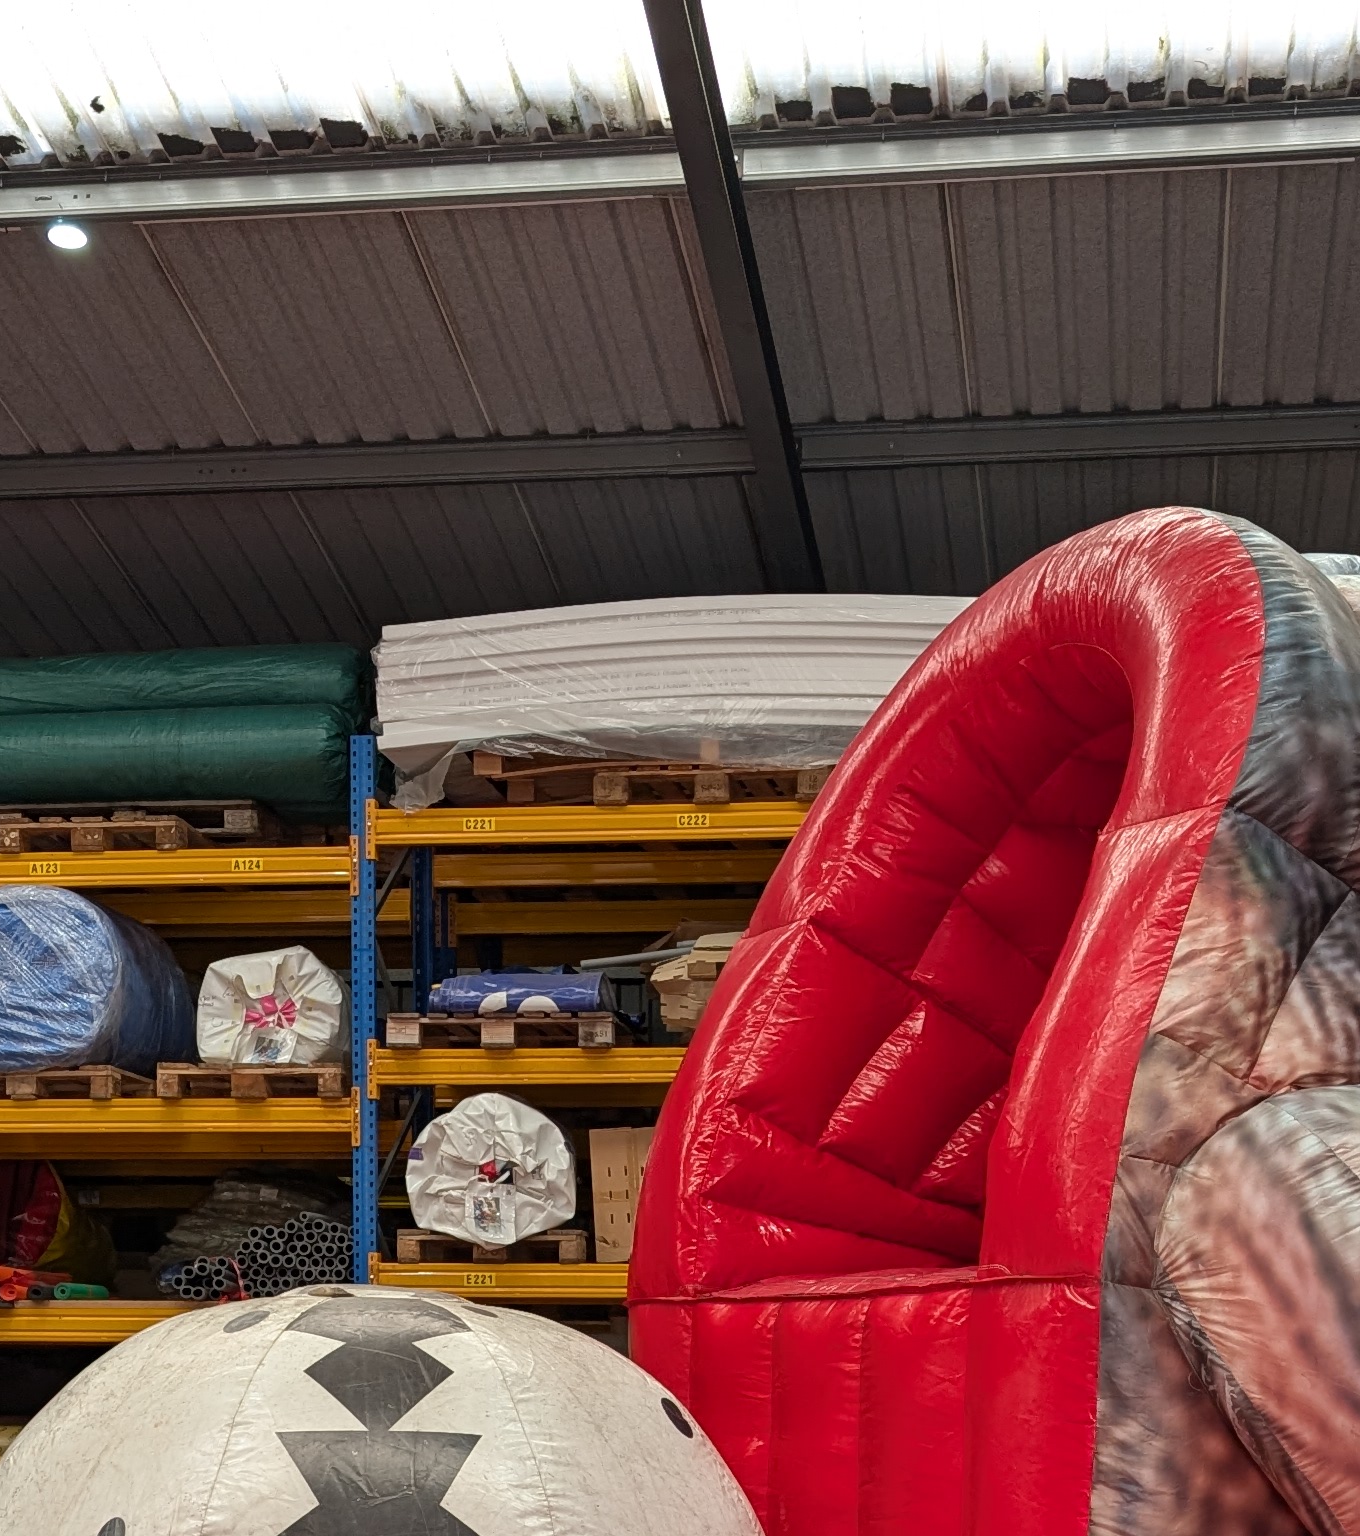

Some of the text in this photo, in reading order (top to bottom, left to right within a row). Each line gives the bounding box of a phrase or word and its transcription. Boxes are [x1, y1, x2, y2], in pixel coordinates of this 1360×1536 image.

[465, 818, 493, 830] C221
[678, 814, 707, 826] C222
[31, 862, 58, 874] A123
[233, 859, 261, 871] A124
[466, 1274, 493, 1285] E221
